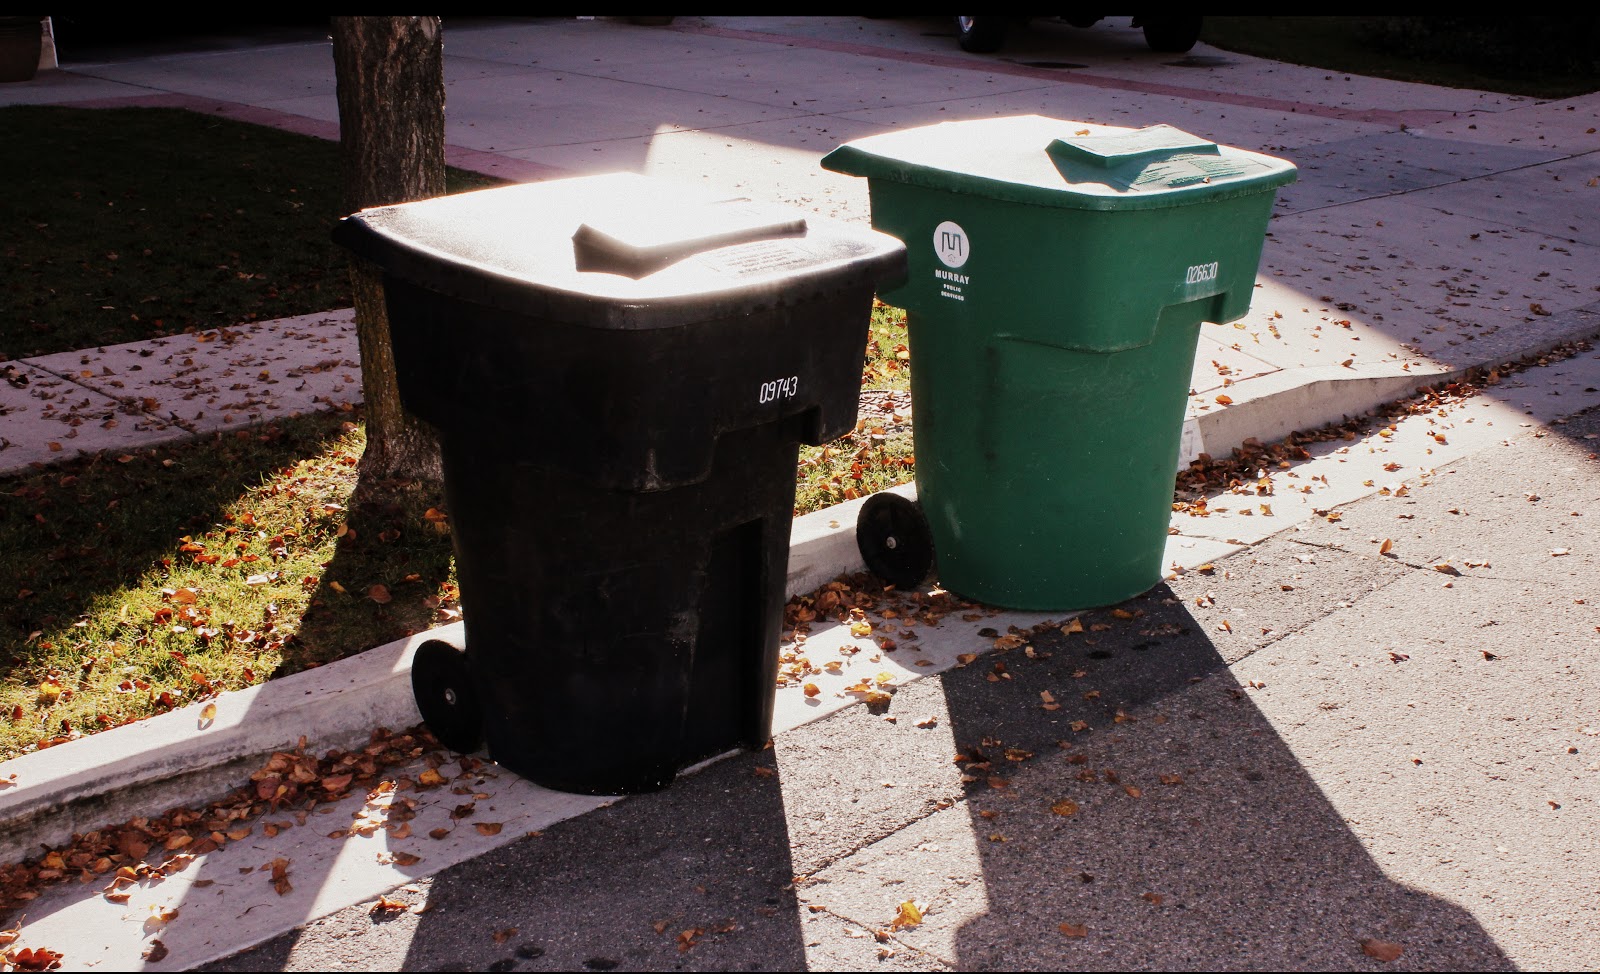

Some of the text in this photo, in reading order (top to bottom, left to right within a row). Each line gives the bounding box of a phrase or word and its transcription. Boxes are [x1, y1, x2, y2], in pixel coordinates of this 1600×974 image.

[935, 269, 969, 284] MURRAY
[1186, 261, 1218, 284] 026630
[943, 284, 961, 292] PUBLIC
[759, 375, 798, 404] 09743
